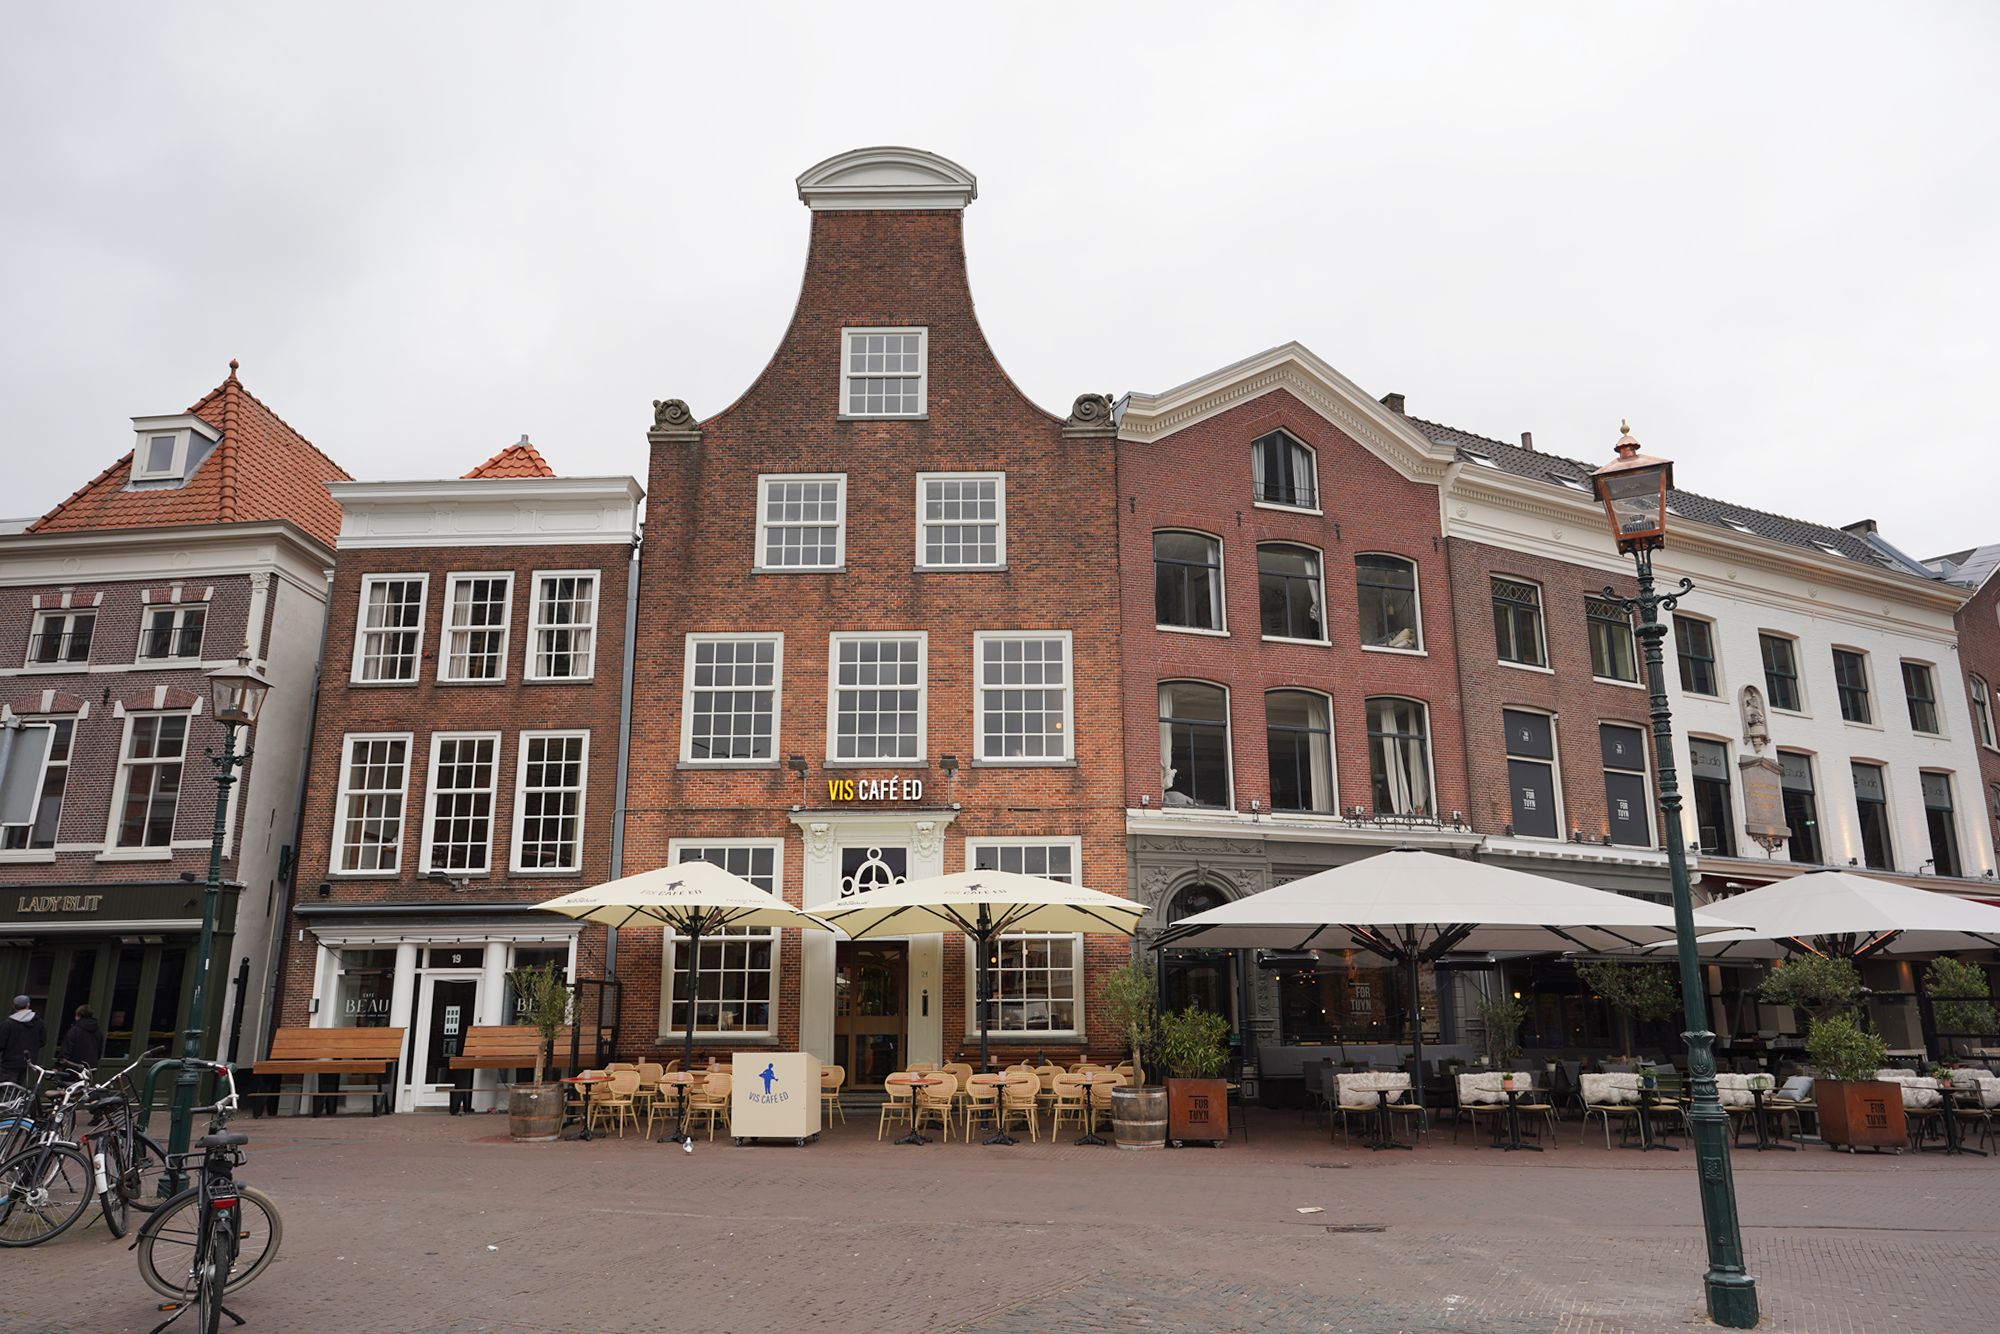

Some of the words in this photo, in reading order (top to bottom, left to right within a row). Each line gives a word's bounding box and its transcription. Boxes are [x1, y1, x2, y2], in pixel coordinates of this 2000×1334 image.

[828, 779, 854, 801] VIS
[859, 775, 899, 801] CAFÉ
[903, 779, 923, 801] ED
[17, 896, 62, 912] LADY
[452, 954, 461, 963] 19
[1356, 986, 1370, 998] FOR
[345, 999, 390, 1013] BEAU
[1351, 999, 1371, 1010] TUYN
[749, 1092, 760, 1103] VIS
[779, 1091, 789, 1102] ED
[1194, 1099, 1209, 1109] FOR
[1871, 1103, 1886, 1113] FOR
[1189, 1110, 1209, 1120] TUYN
[1865, 1114, 1888, 1125] TUYN
